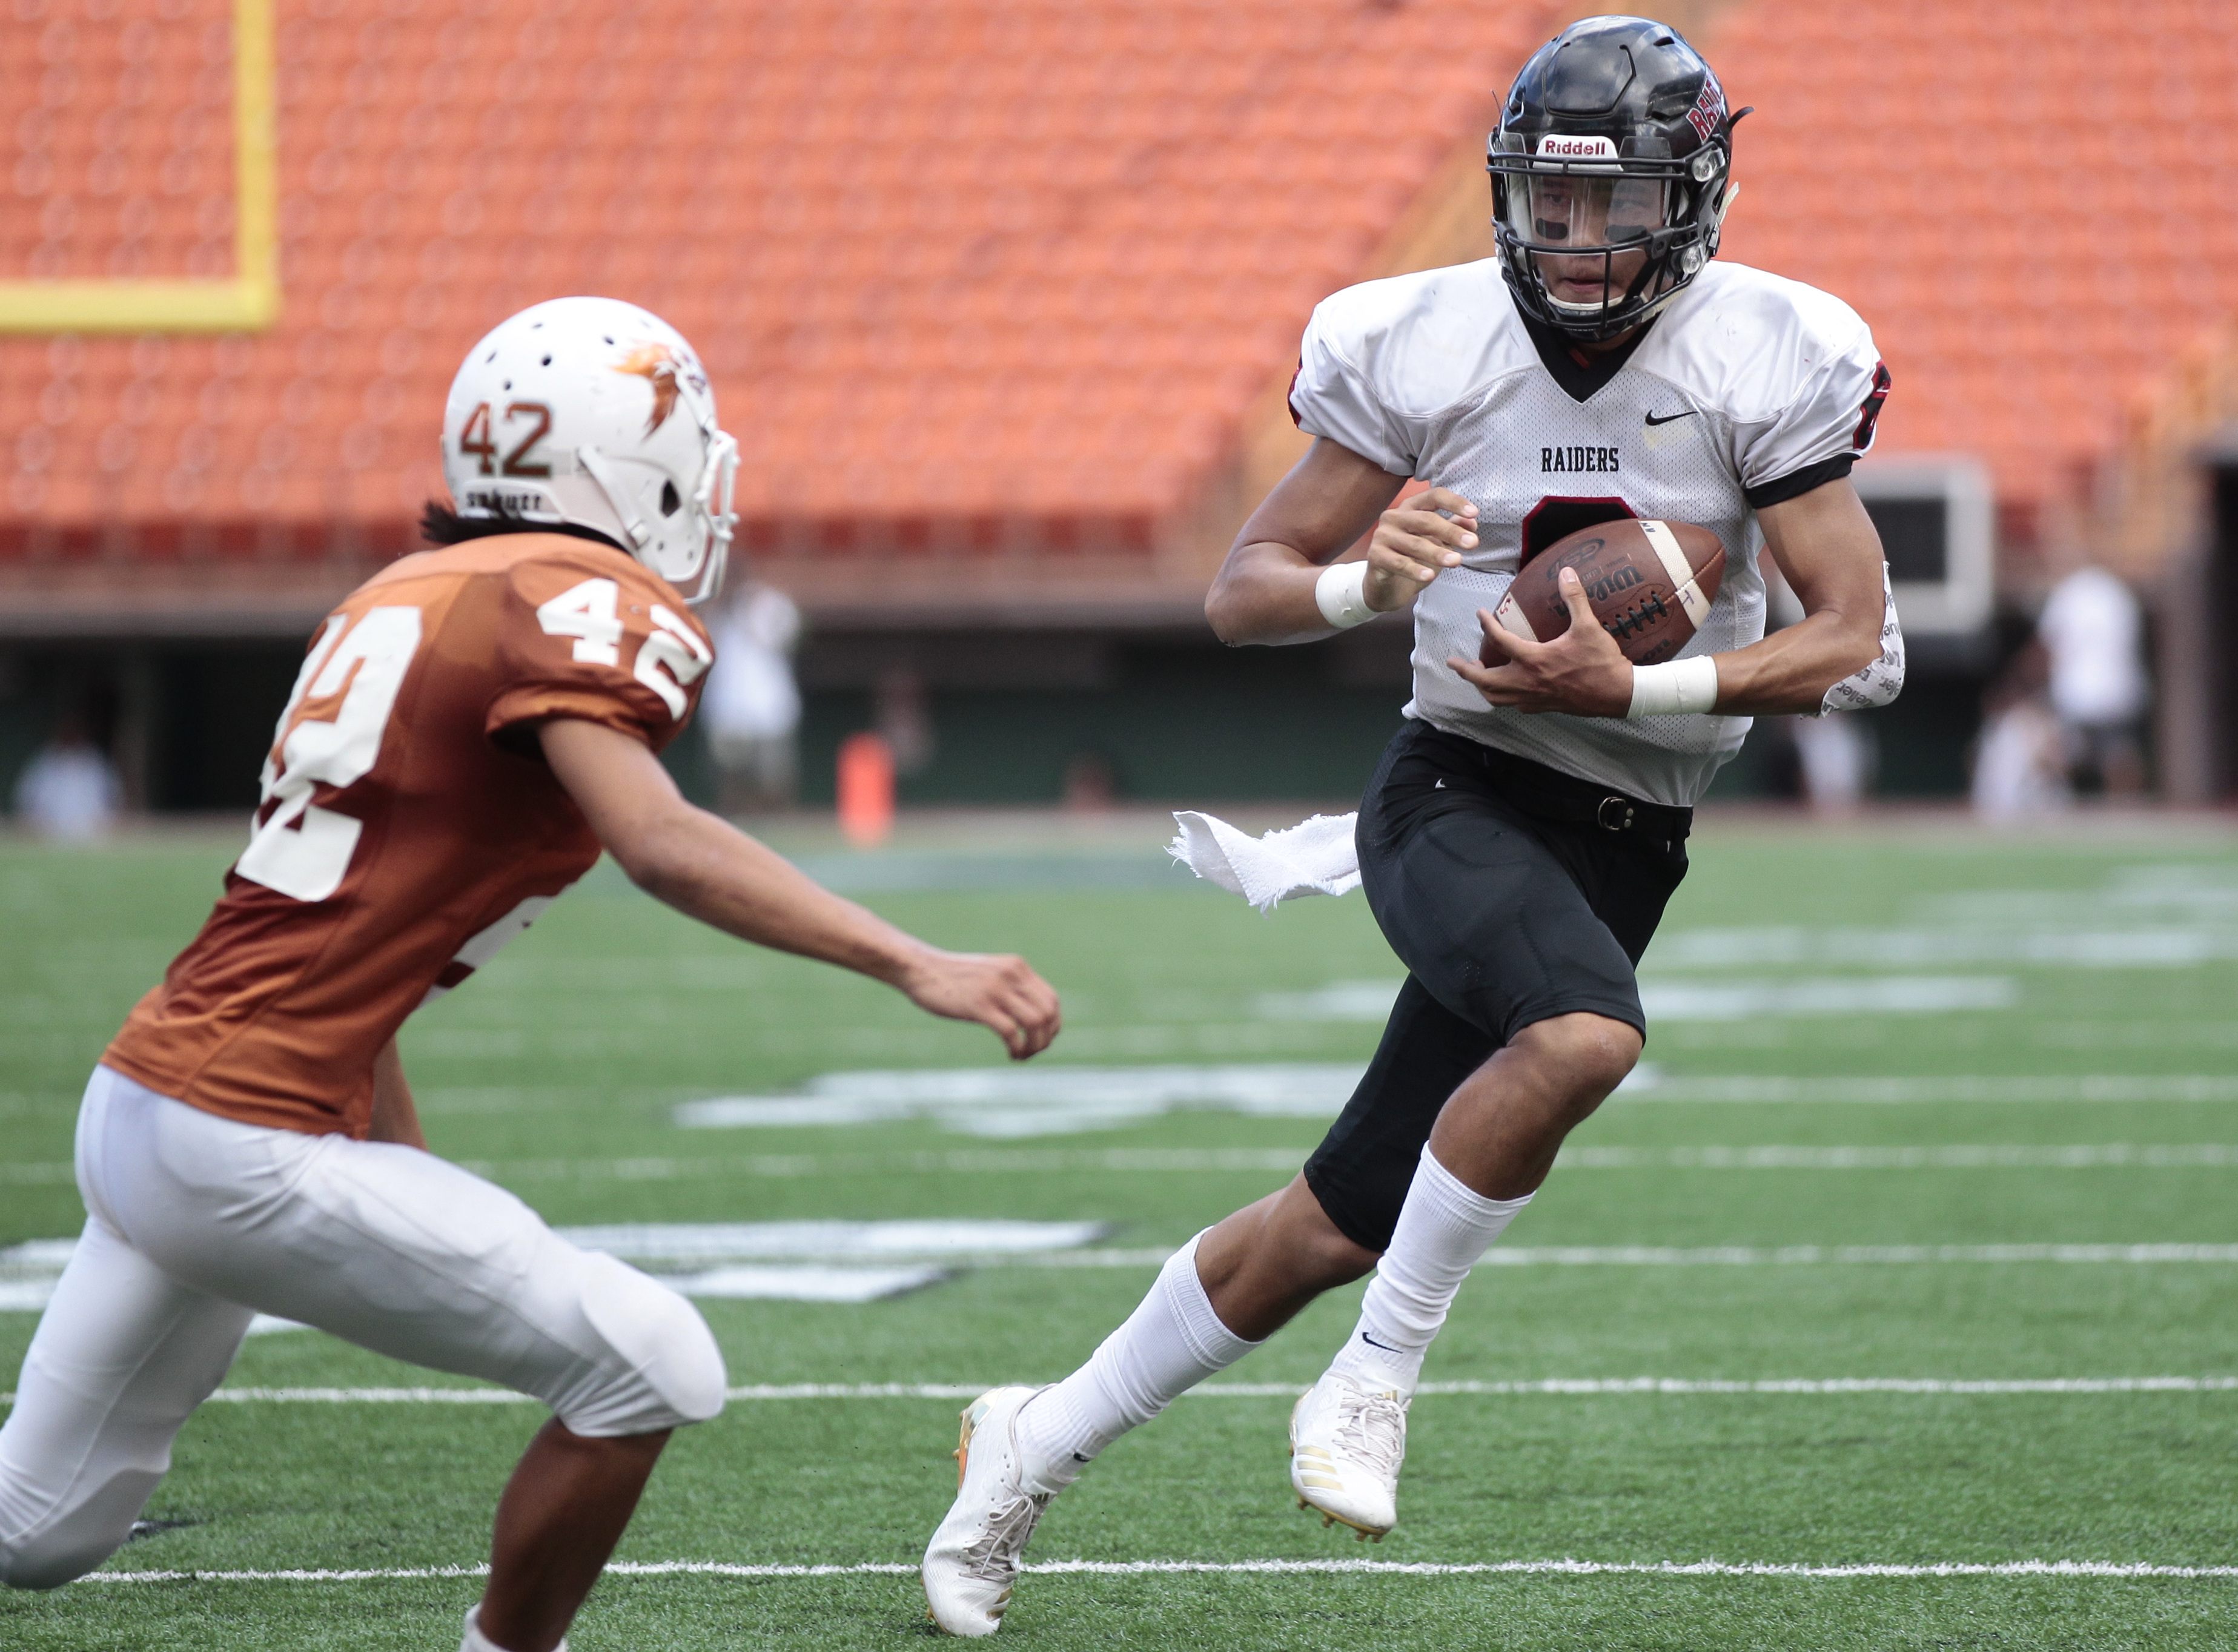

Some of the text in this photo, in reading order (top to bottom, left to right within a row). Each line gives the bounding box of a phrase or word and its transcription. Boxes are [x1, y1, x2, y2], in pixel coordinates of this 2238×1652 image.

[1544, 140, 1605, 155] Riddell
[459, 401, 552, 478] 42
[1541, 447, 1619, 472] RAIDERS
[1552, 564, 1646, 618] Wiln
[538, 578, 715, 721] 42
